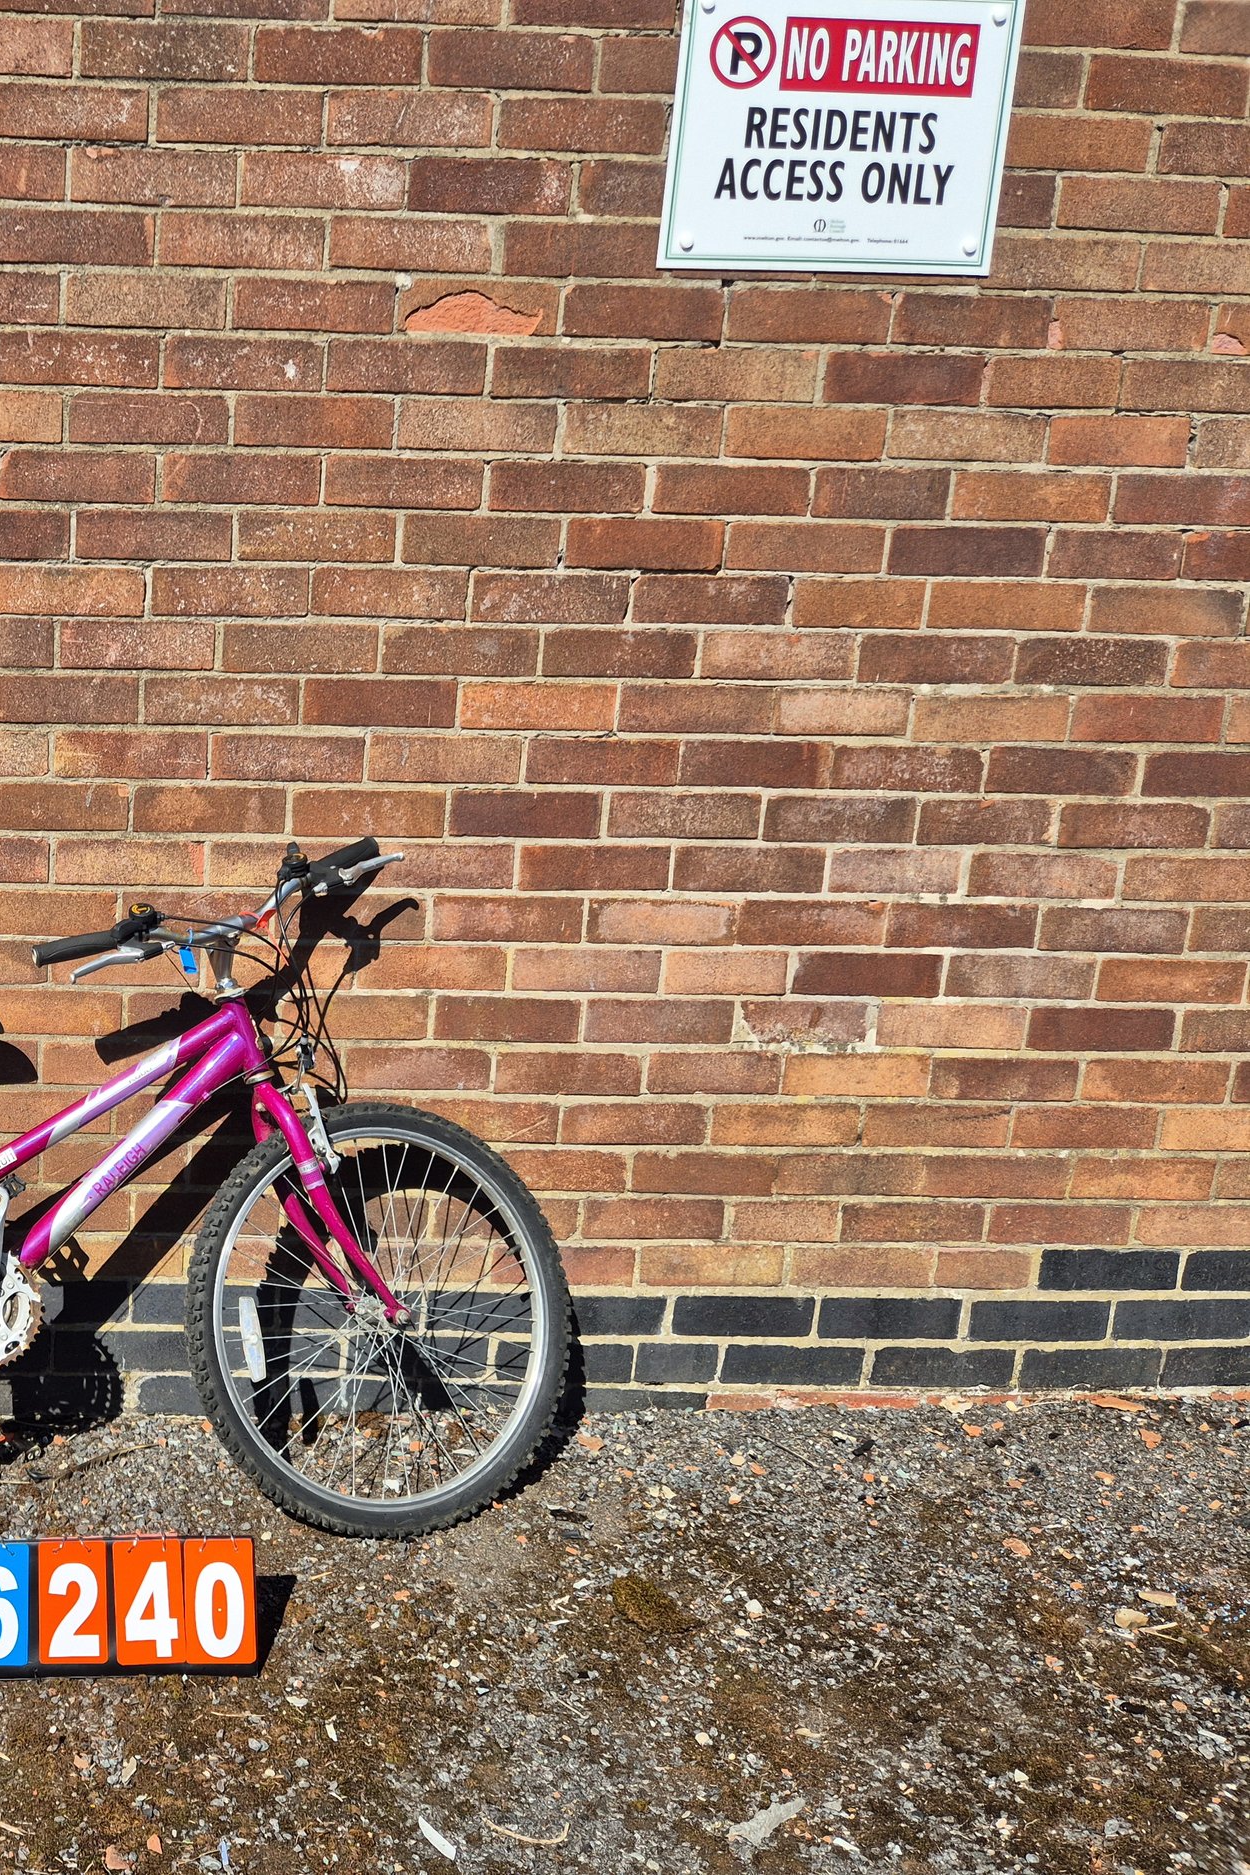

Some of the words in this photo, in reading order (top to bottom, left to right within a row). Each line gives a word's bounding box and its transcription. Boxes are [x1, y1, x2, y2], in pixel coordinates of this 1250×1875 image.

[786, 26, 830, 81] NO
[841, 28, 972, 87] PARKING
[744, 106, 938, 154] RESIDENTS
[714, 157, 845, 203] ACCESS
[861, 161, 955, 205] ONLY
[92, 1142, 146, 1197] RALEIGH
